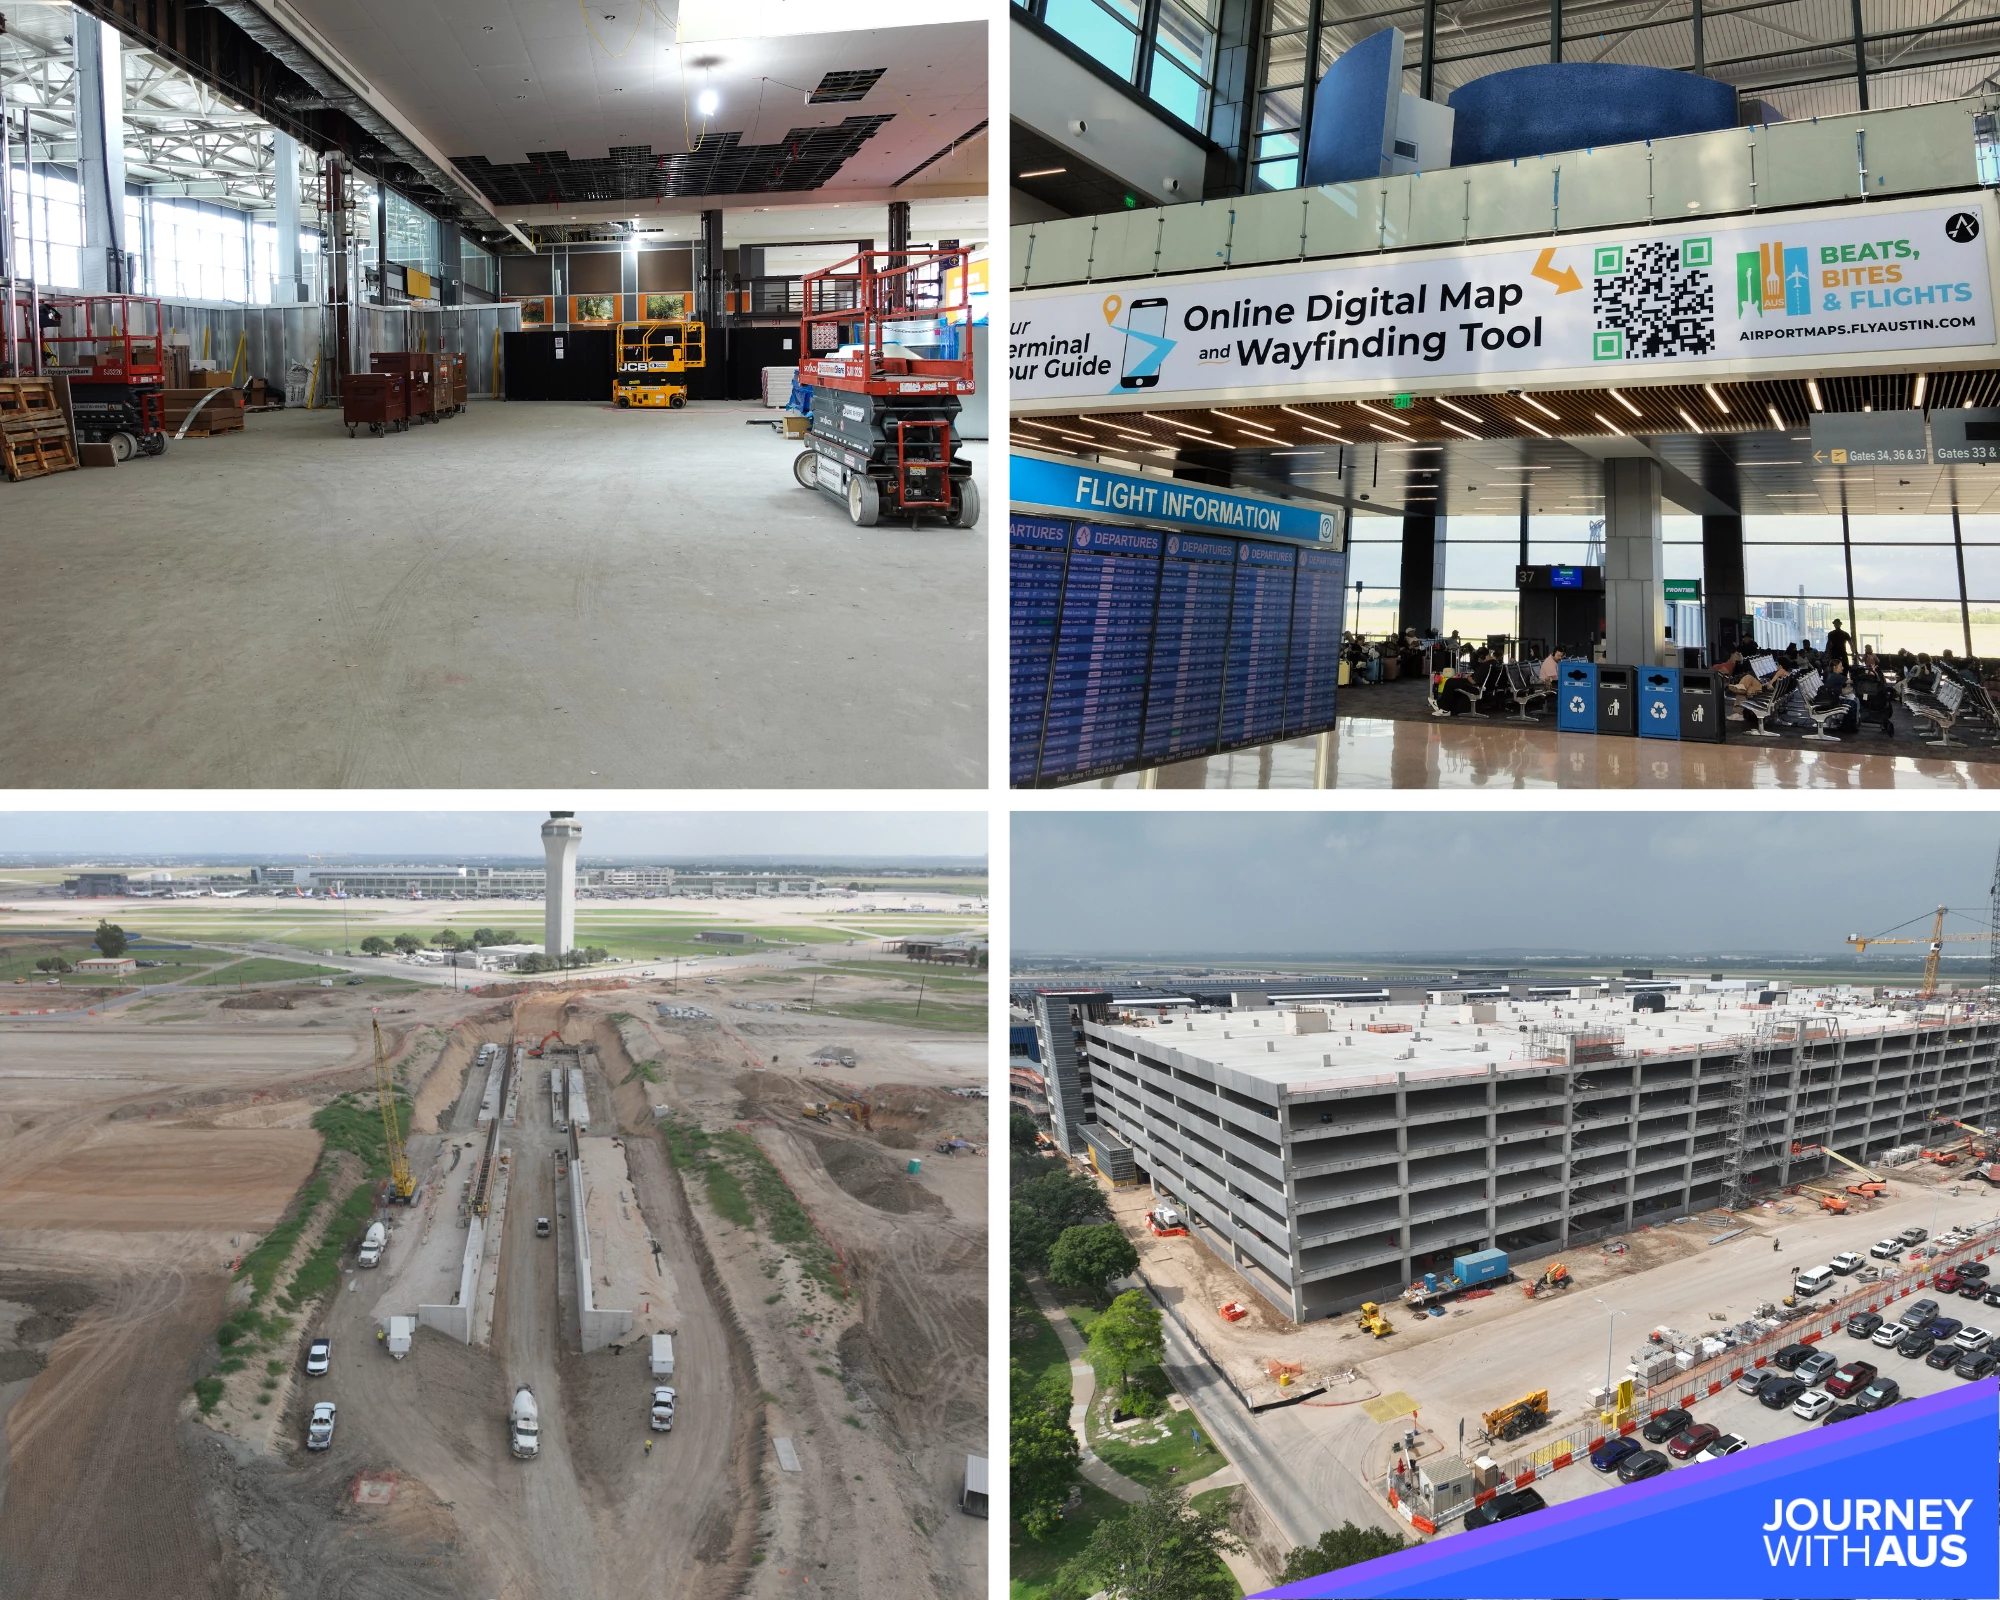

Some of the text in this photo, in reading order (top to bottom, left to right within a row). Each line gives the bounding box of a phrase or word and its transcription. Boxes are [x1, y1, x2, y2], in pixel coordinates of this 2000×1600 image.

[1821, 239, 1920, 265] BEATS,
[1822, 264, 1903, 288] BITES
[1763, 298, 1785, 308] AUS
[1823, 282, 1972, 312] & FLIGHTS
[1184, 281, 1523, 332] Online Digital Map
[1739, 316, 1976, 342] AIRPORTMAPS.FLYAUSTIN.COM
[1199, 316, 1542, 370] and Wayfinding Tool
[48, 368, 89, 376] EquipmentShare
[619, 363, 648, 371] JCB
[1044, 355, 1112, 378] Guide
[1850, 449, 1927, 462] Gates 34, 36 & 37
[1938, 447, 1997, 459] Gates 33 &
[1076, 476, 1280, 532] FLIGHT INFORMATION
[1095, 532, 1158, 549] DEPARTURES
[1182, 542, 1232, 556] DEPARTURES
[1252, 549, 1293, 562] DEPARTURES
[1309, 555, 1343, 567] DEPARTURES
[1519, 571, 1535, 583] 37
[1071, 772, 1084, 780] June
[1116, 763, 1124, 771] AM
